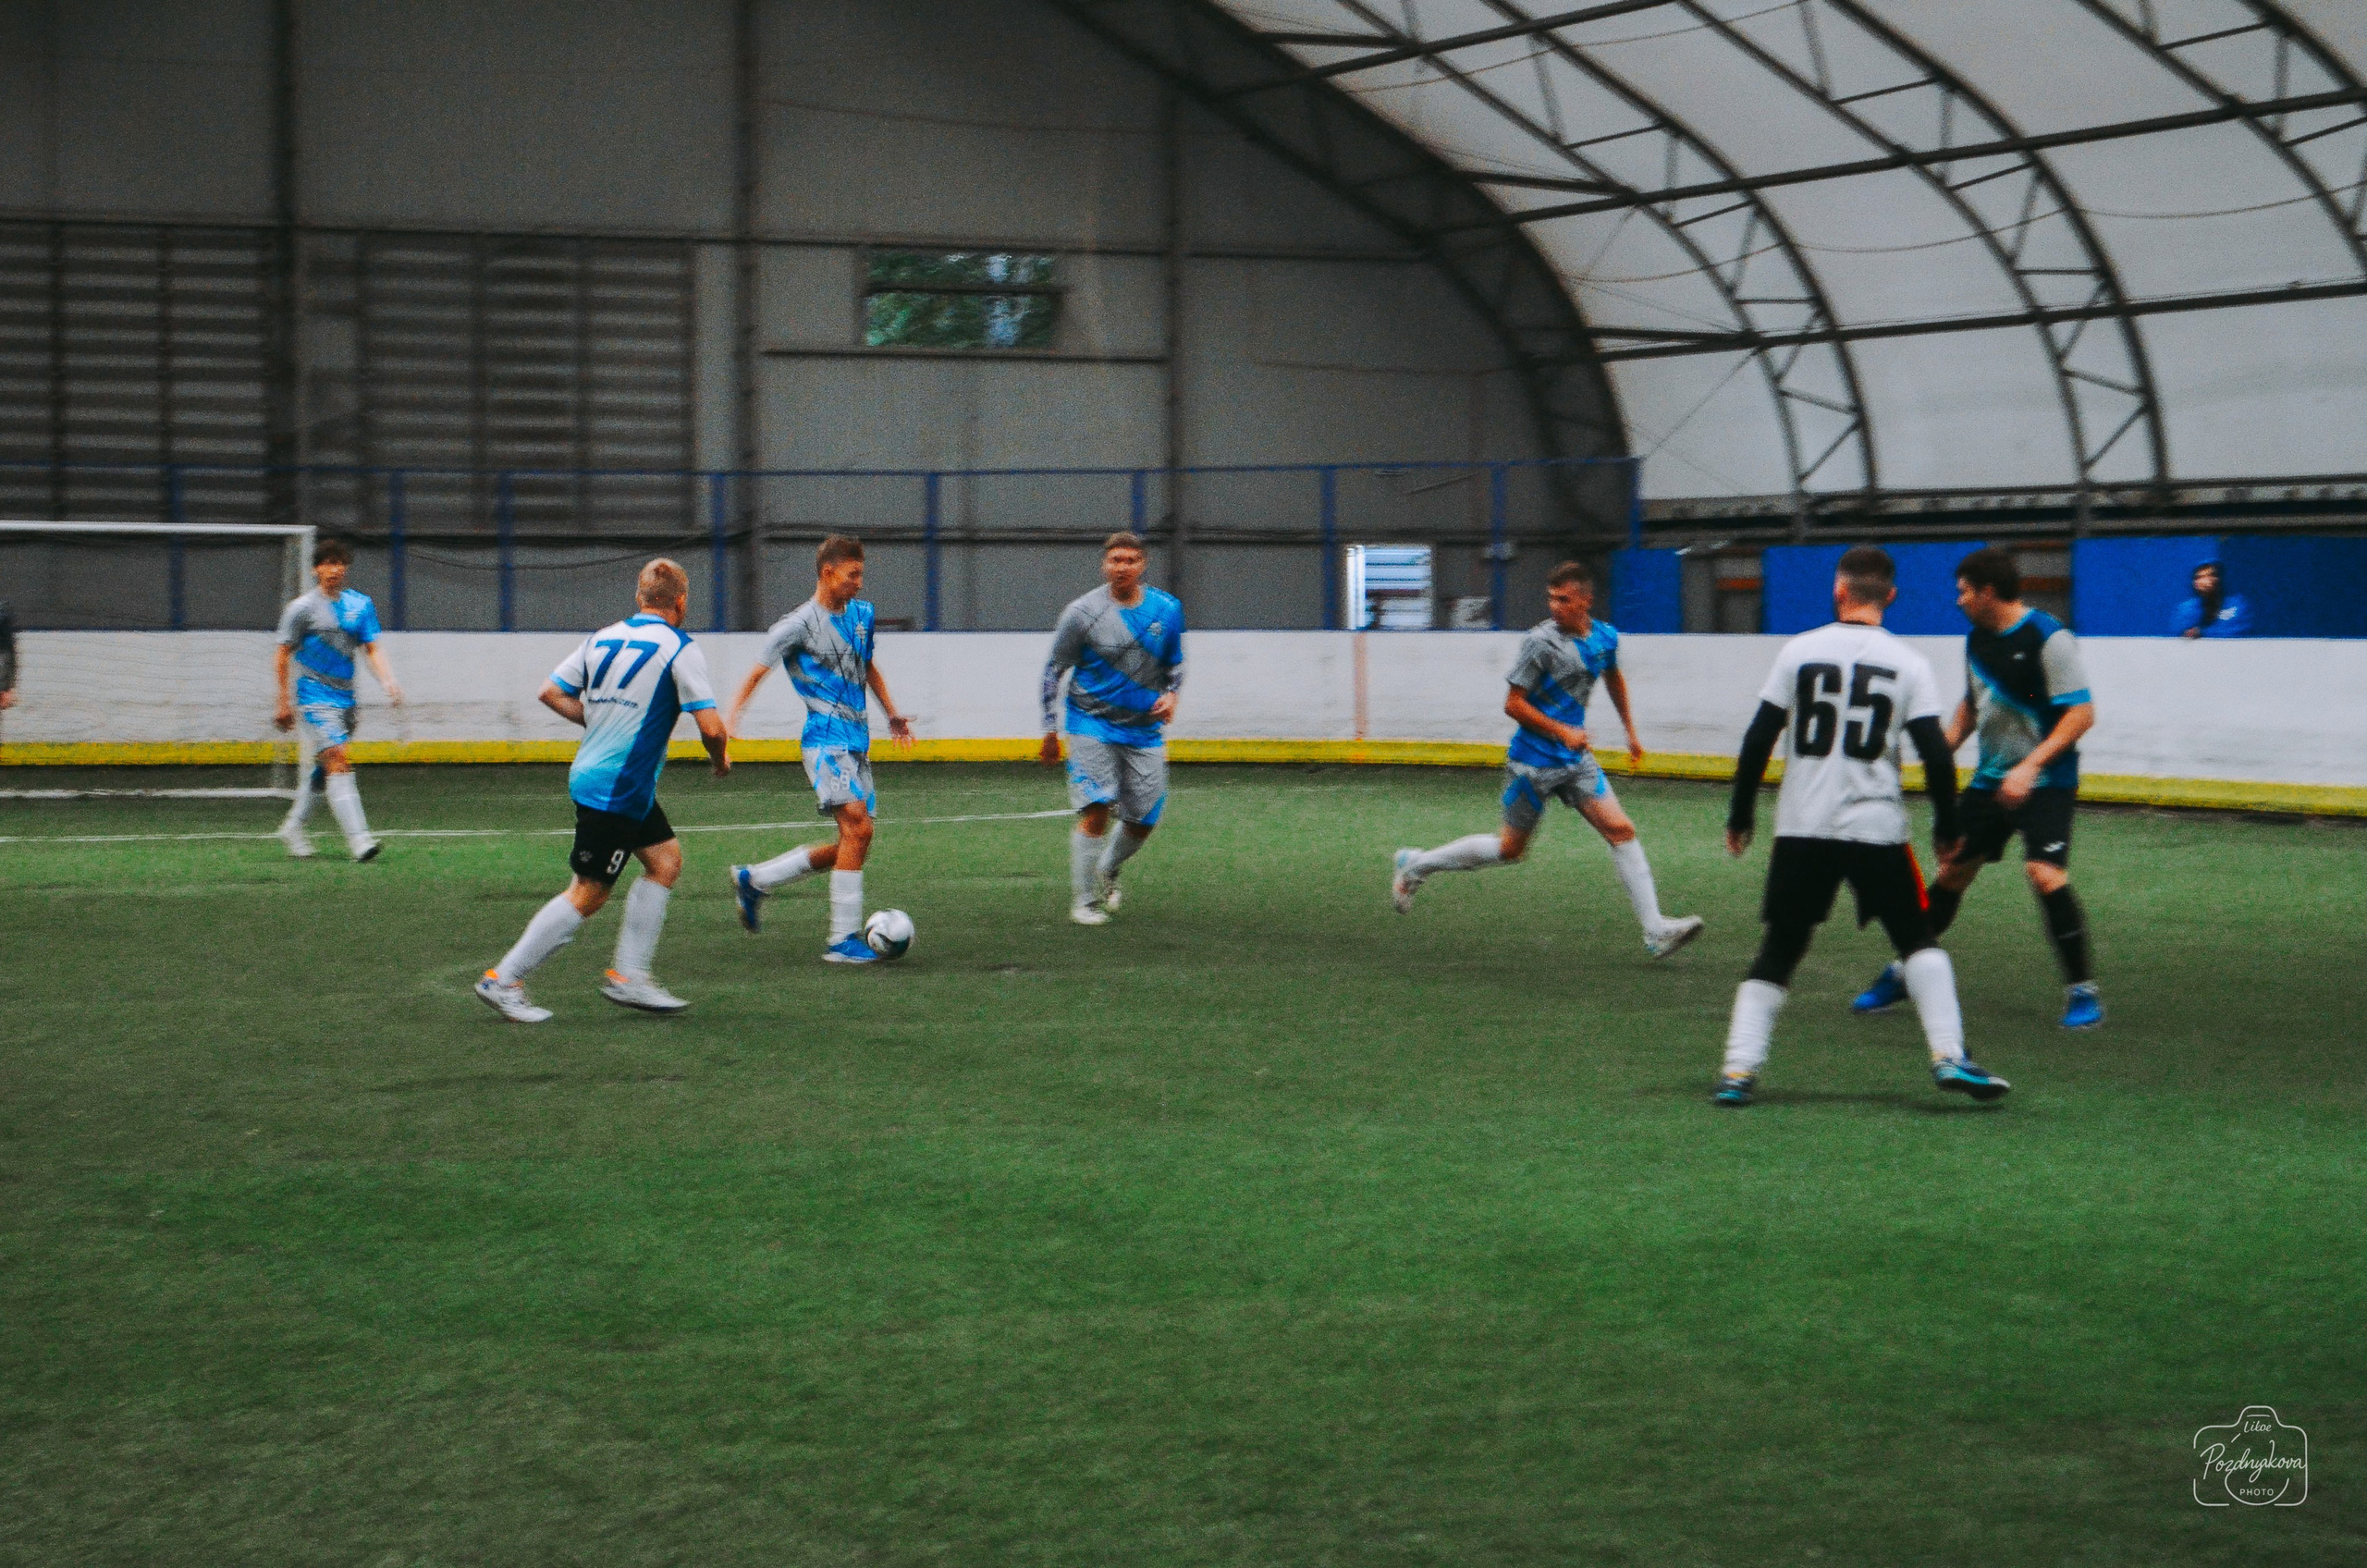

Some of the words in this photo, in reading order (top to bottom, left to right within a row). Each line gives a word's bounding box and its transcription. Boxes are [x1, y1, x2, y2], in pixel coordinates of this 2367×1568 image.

[591, 639, 659, 690] 77
[1796, 663, 1896, 759] 65
[607, 849, 624, 874] 9
